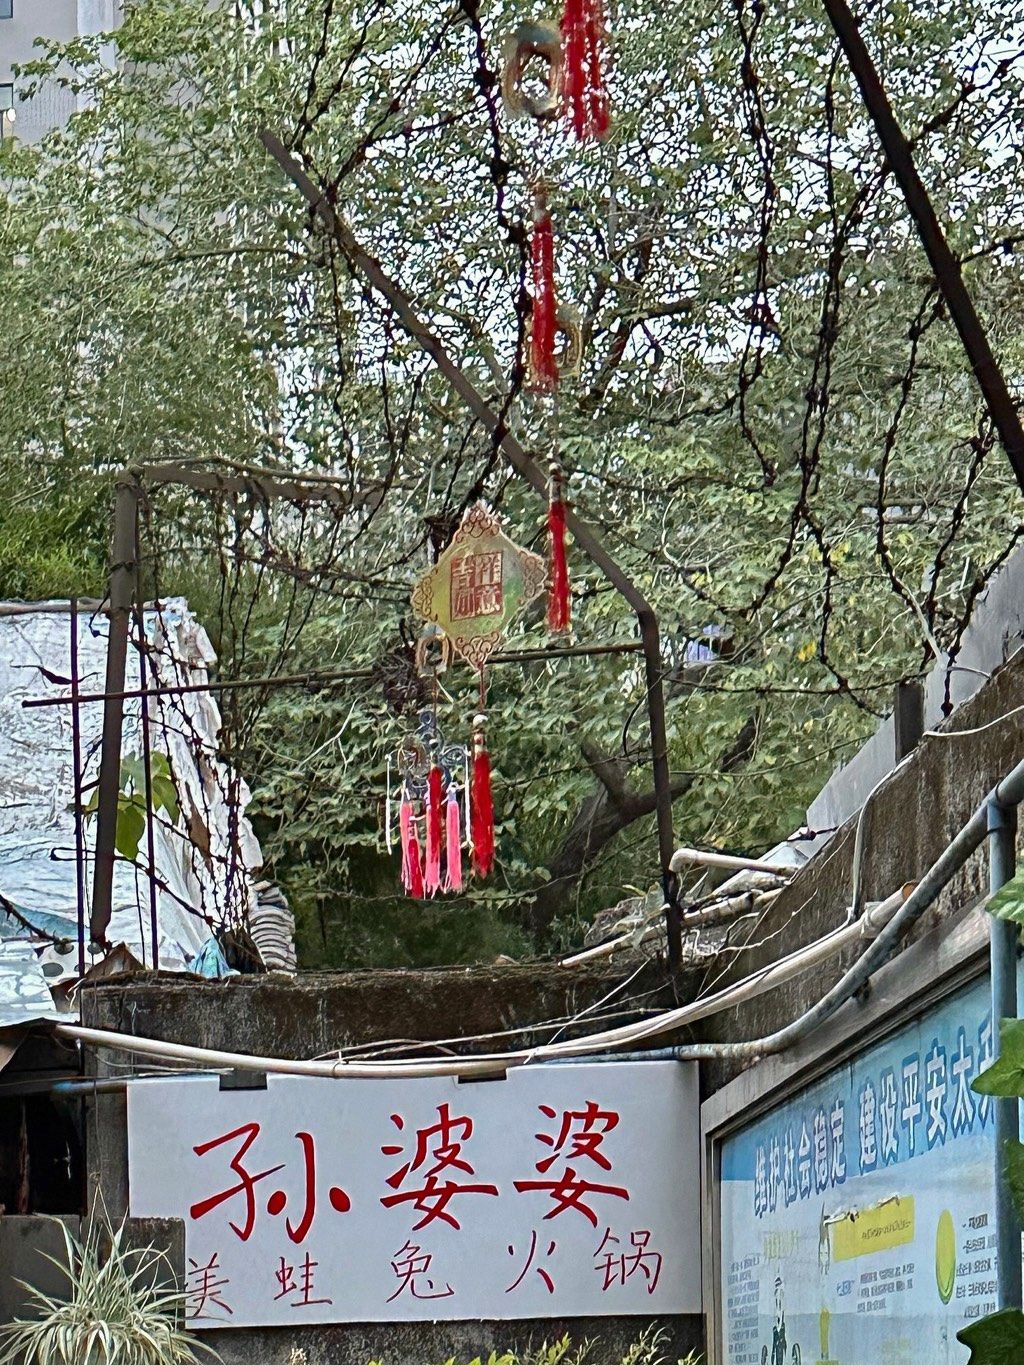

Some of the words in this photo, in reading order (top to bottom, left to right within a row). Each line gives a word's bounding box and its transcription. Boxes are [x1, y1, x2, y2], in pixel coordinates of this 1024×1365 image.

[189, 1101, 629, 1244] 孙婆婆
[183, 1227, 664, 1318] 美蛙兔火锅
